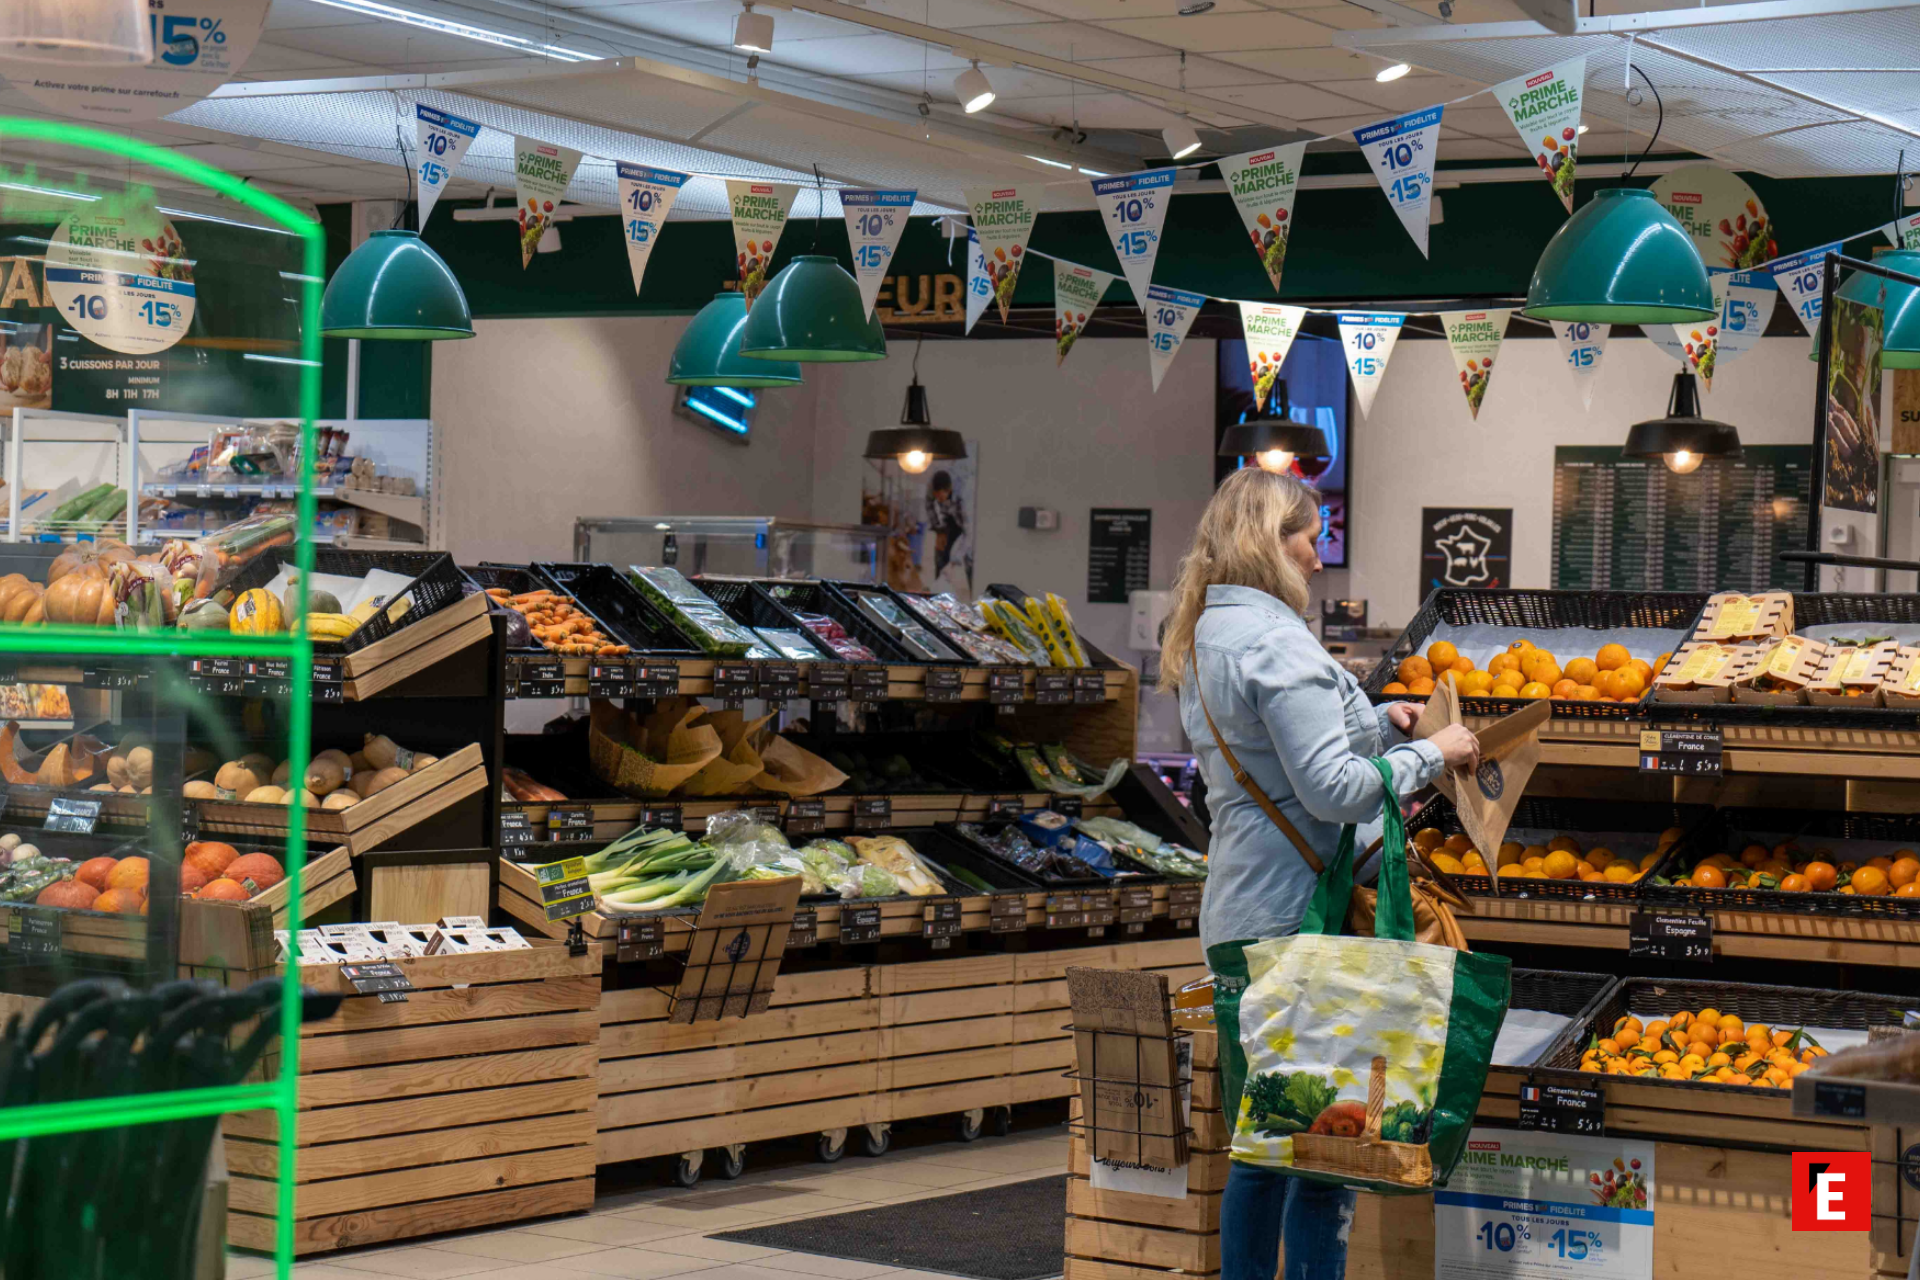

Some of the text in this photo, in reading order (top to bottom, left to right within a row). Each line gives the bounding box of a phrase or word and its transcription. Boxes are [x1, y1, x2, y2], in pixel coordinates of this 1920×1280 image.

[34, 80, 64, 90] Activez
[67, 83, 90, 92] votre
[92, 85, 116, 95] prime
[1520, 80, 1566, 106] PRIME
[1514, 86, 1578, 122] MARCHÉ
[1361, 126, 1389, 141] PRIMES
[527, 153, 562, 172] PRIME
[1381, 138, 1423, 170] -10%
[518, 163, 568, 185] MARCHÉ
[1242, 162, 1285, 181] PRIME
[1098, 174, 1169, 191] PRIMES FIDÉLITÉ
[1233, 170, 1294, 195] MARCHÉ
[1389, 172, 1430, 203] -15%
[628, 189, 662, 211] -10%
[743, 195, 778, 208] PRIME
[985, 201, 1023, 213] PRIME
[734, 207, 784, 221] MARCHÉ
[977, 208, 1032, 226] MARCHÉ
[1112, 197, 1154, 223] -10%
[69, 225, 117, 238] PRIME
[626, 219, 657, 242] -15%
[856, 214, 894, 236] -10%
[69, 236, 135, 251] MARCHÉ
[1117, 230, 1157, 255] -15%
[855, 245, 891, 267] -15%
[1774, 260, 1798, 271] PRIMES
[138, 279, 173, 290] FIDÉLITÉ
[1066, 274, 1095, 289] PRIME
[1058, 282, 1098, 301] MARCHÉ
[139, 301, 181, 327] -15%
[1153, 308, 1184, 326] -10%
[1255, 315, 1286, 327] PRIME
[1459, 322, 1493, 332] PRIME
[1151, 332, 1180, 351] -15%
[1352, 332, 1385, 350] -10%
[1452, 329, 1500, 343] MARCHÉ
[60, 357, 159, 370] 3 CUISSONS PAR JOUR
[1568, 346, 1602, 367] -15%
[1352, 358, 1384, 375] -15%
[106, 390, 118, 399] 8H
[143, 389, 159, 399] 17H
[1678, 742, 1704, 750] France
[562, 888, 583, 897] France
[1666, 926, 1696, 937] Espagne
[1557, 1097, 1586, 1107] France
[1458, 1151, 1568, 1171] RIME MARCHÉ
[1503, 1201, 1586, 1216] PRIMES FIDÉLITÉ
[1546, 1218, 1569, 1226] JOURS
[1477, 1221, 1602, 1260] -10% -15%
